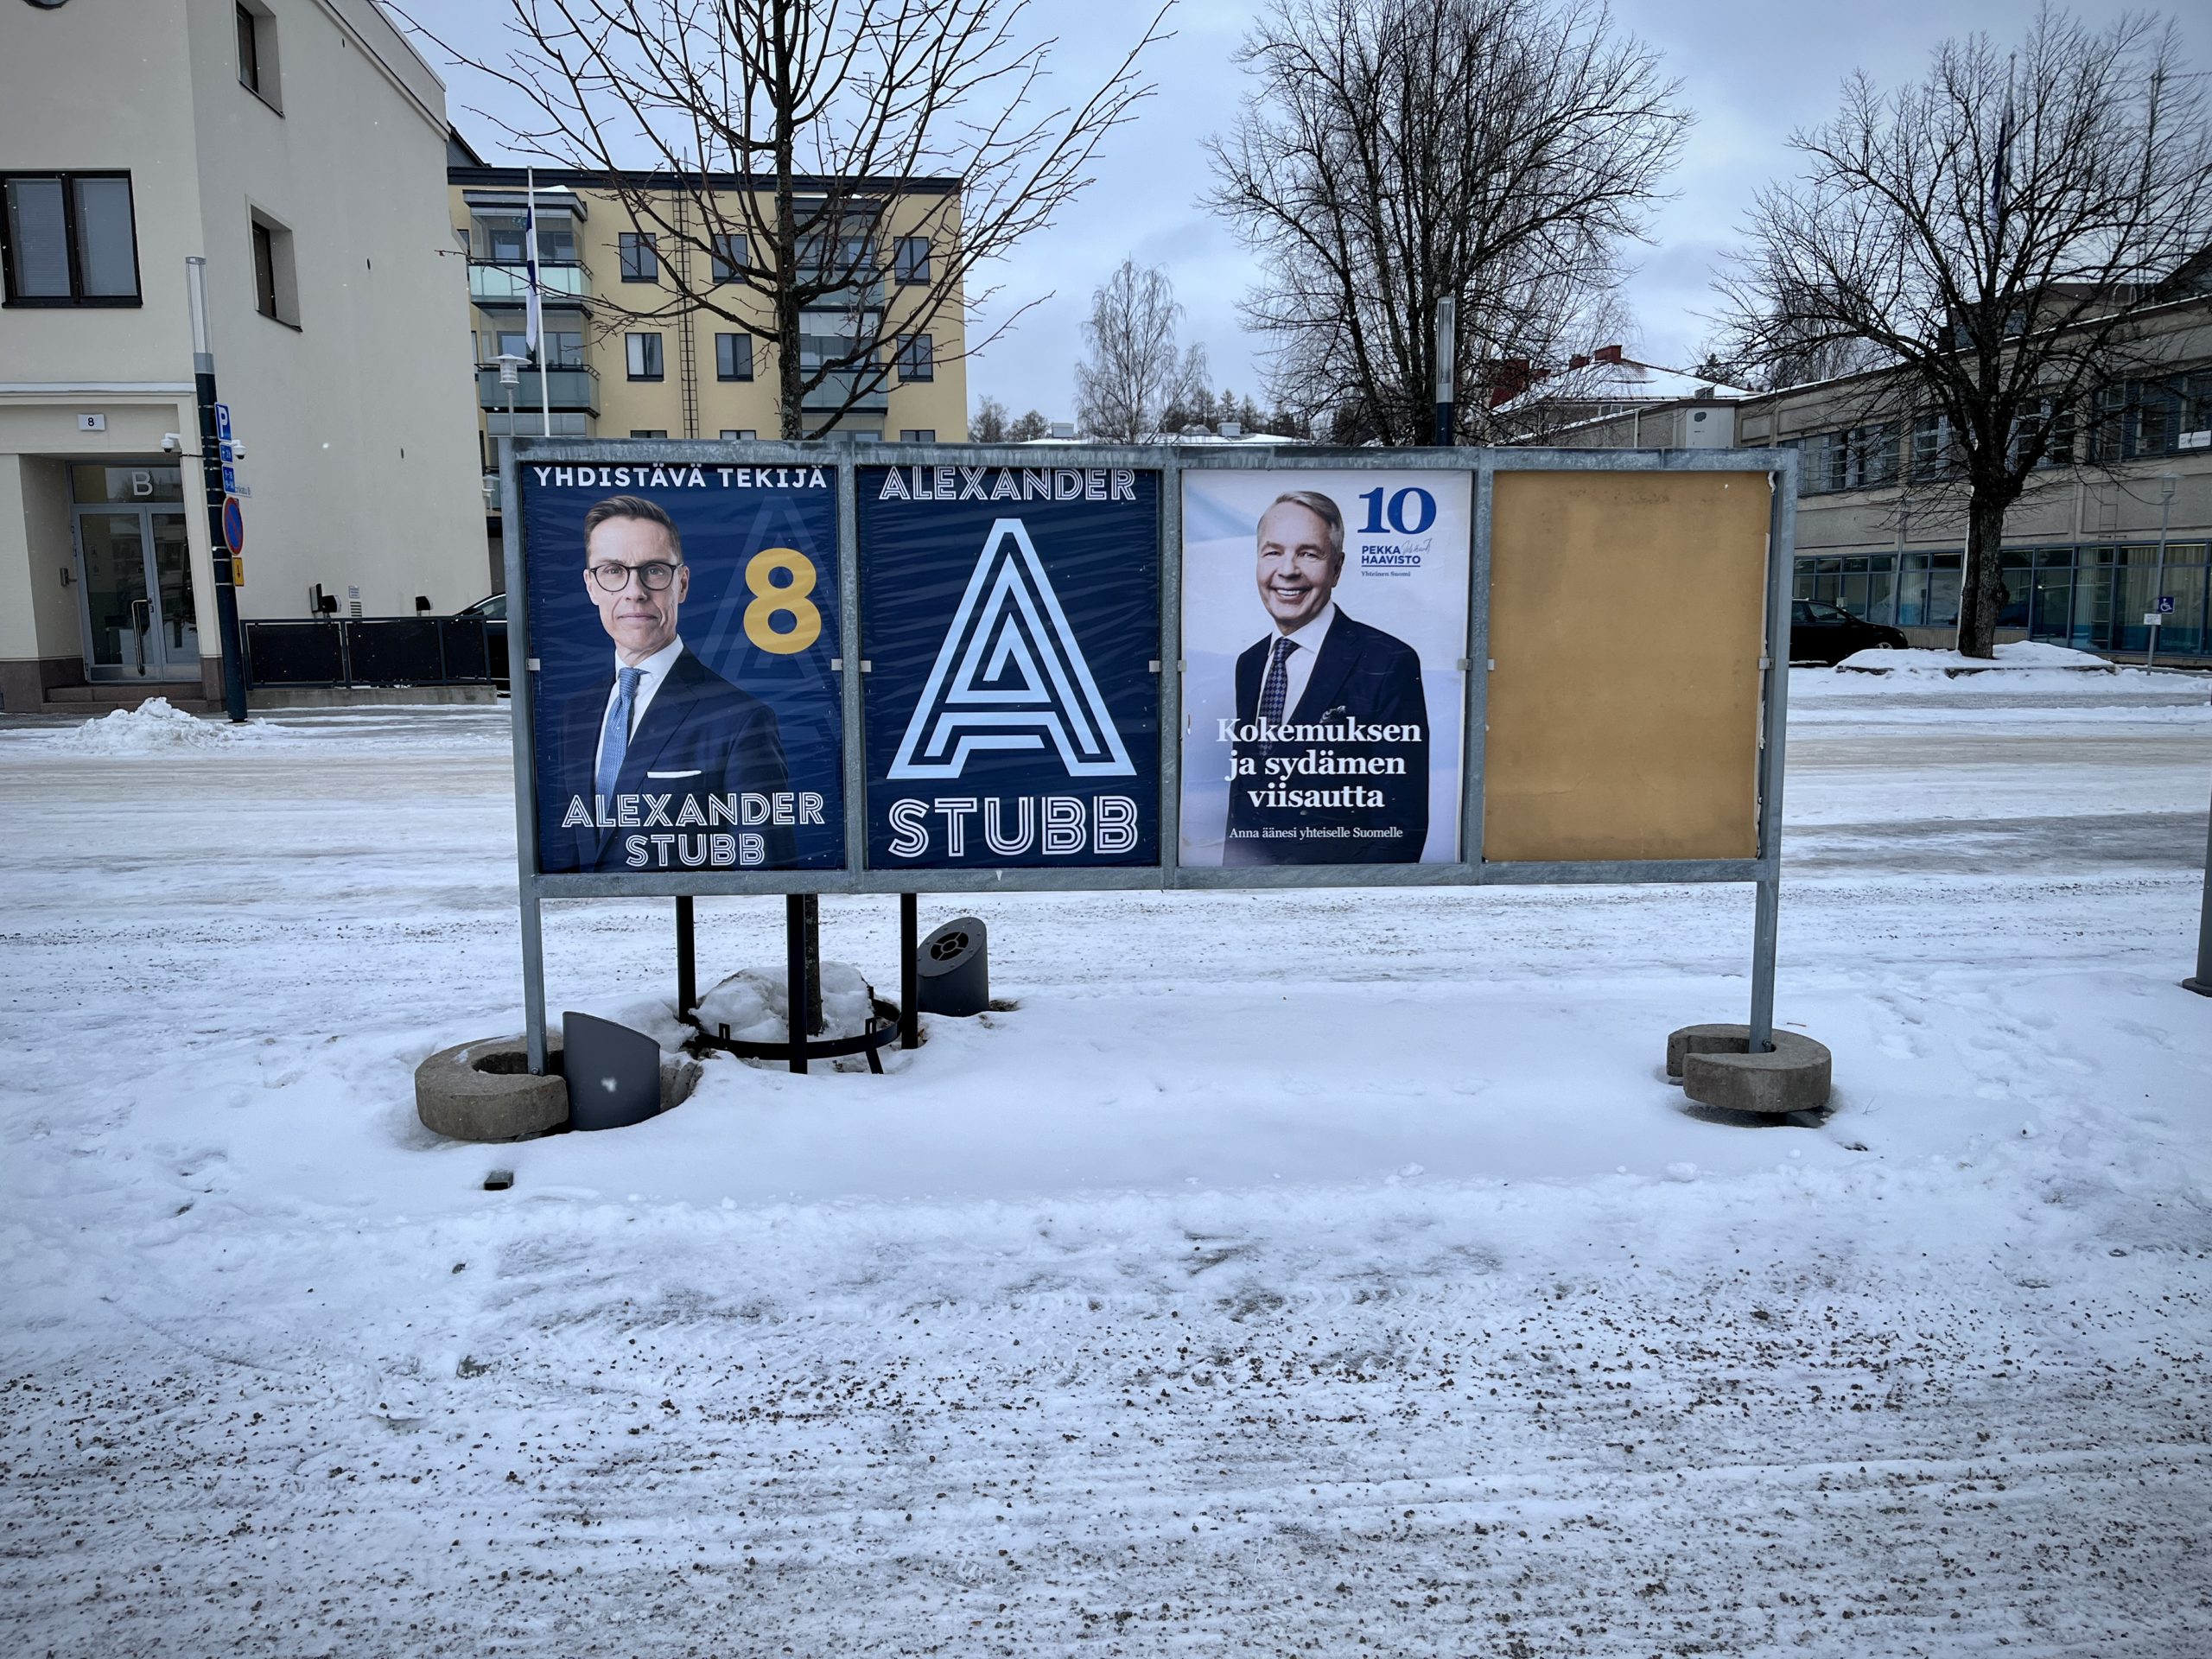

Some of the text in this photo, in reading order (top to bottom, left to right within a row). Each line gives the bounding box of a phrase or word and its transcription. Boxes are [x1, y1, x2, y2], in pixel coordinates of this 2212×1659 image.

[87, 416, 95, 427] 8
[217, 405, 228, 438] P
[132, 471, 153, 496] B
[533, 463, 827, 488] YHDISTÄVÄ TEKIJÄ
[878, 466, 1137, 500] ALEXANDER
[1357, 486, 1438, 535] 10
[1361, 545, 1402, 555] PEKKA
[1361, 555, 1421, 564] HAAVISTO
[743, 547, 822, 655] 8
[887, 518, 1138, 779] A
[1216, 716, 1422, 743] Kokemuksen
[1224, 749, 1407, 782] ja sydämen
[562, 791, 826, 828] ALEXANDER
[1247, 782, 1386, 808] viisautta
[887, 796, 1138, 858] STUBB
[1229, 826, 1404, 841] Anna äänesi yhteiselle Suomelle
[626, 833, 766, 868] STUBB
